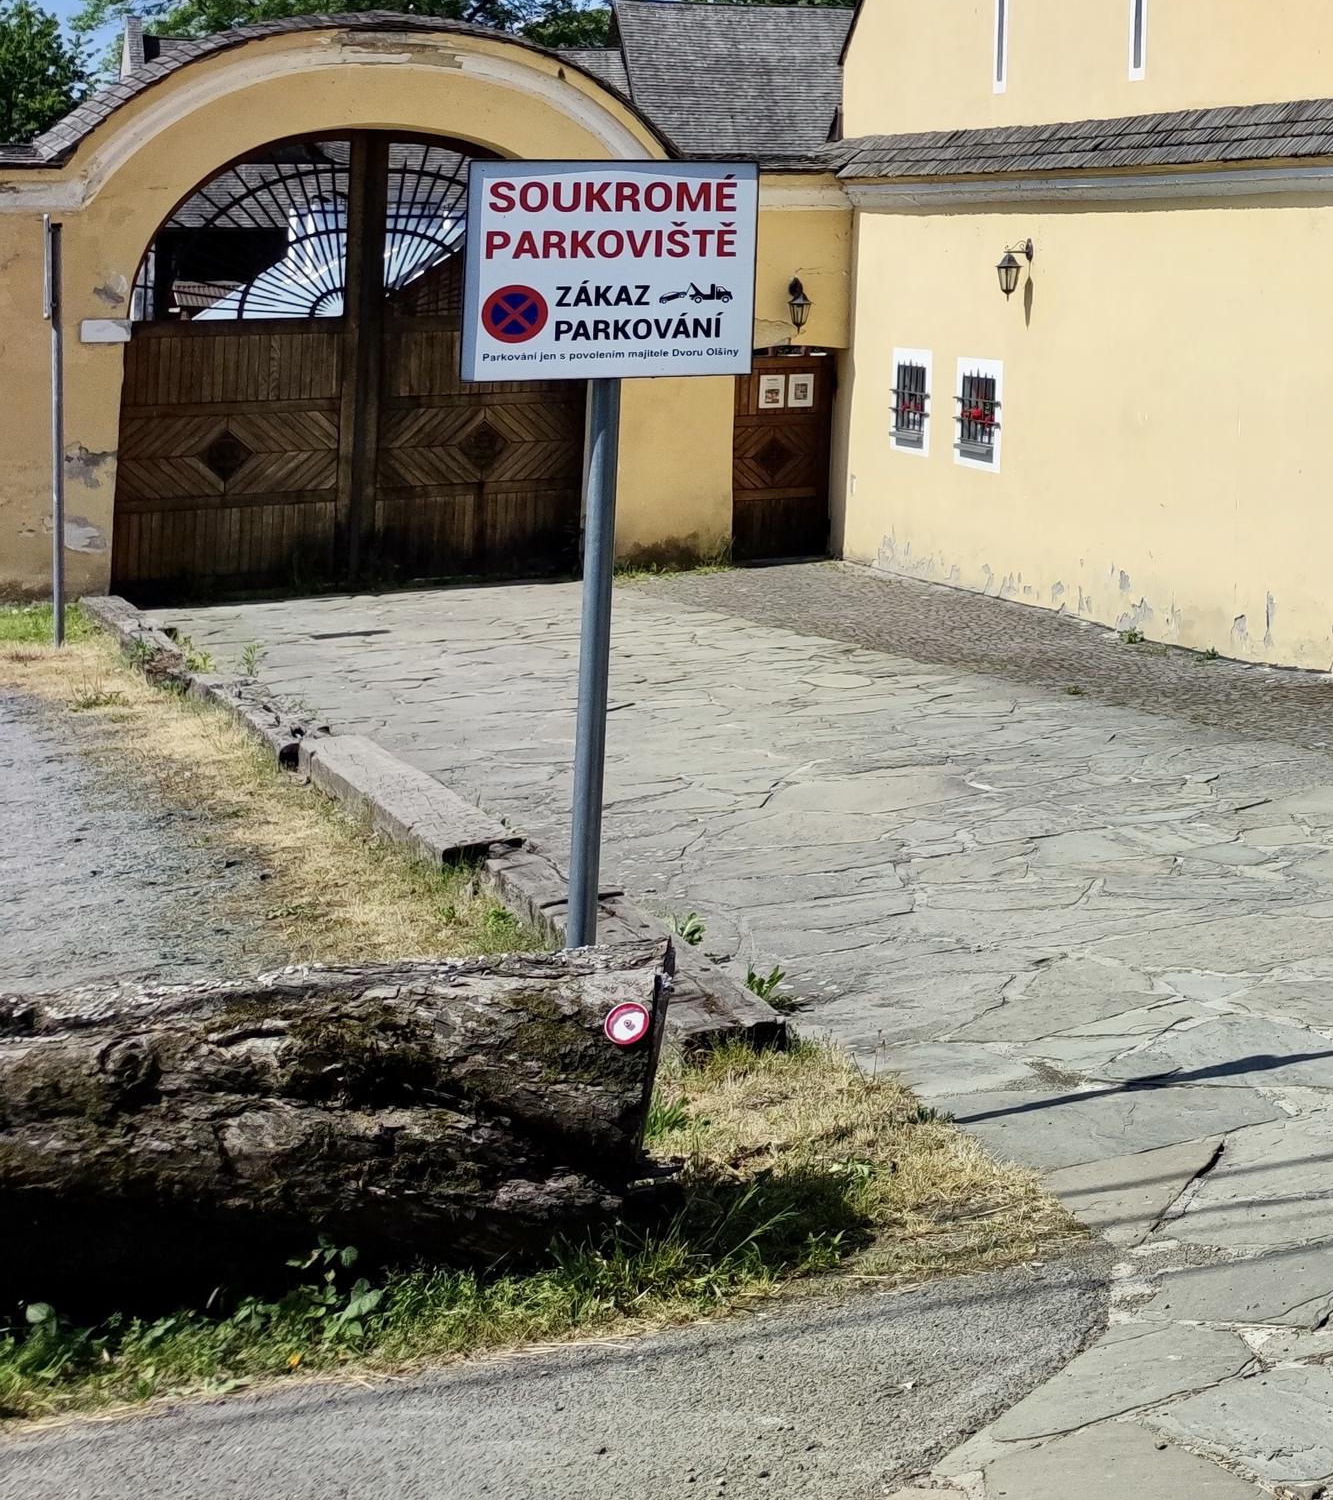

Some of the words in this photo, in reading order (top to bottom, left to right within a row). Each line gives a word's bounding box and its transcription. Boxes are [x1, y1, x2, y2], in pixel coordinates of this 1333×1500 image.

[488, 174, 738, 213] SOUKROMÉ
[485, 221, 737, 260] PARKOVIŠTĚ
[555, 280, 651, 308] ZÁKAZ
[554, 312, 724, 342] PARKOVÁNÍ
[482, 352, 537, 362] Parkování
[539, 351, 556, 362] jen
[559, 352, 566, 360] s
[569, 350, 625, 361] povolením
[628, 349, 669, 359] majitele
[672, 348, 703, 357] Dvoru
[706, 347, 739, 358] Olšiny
